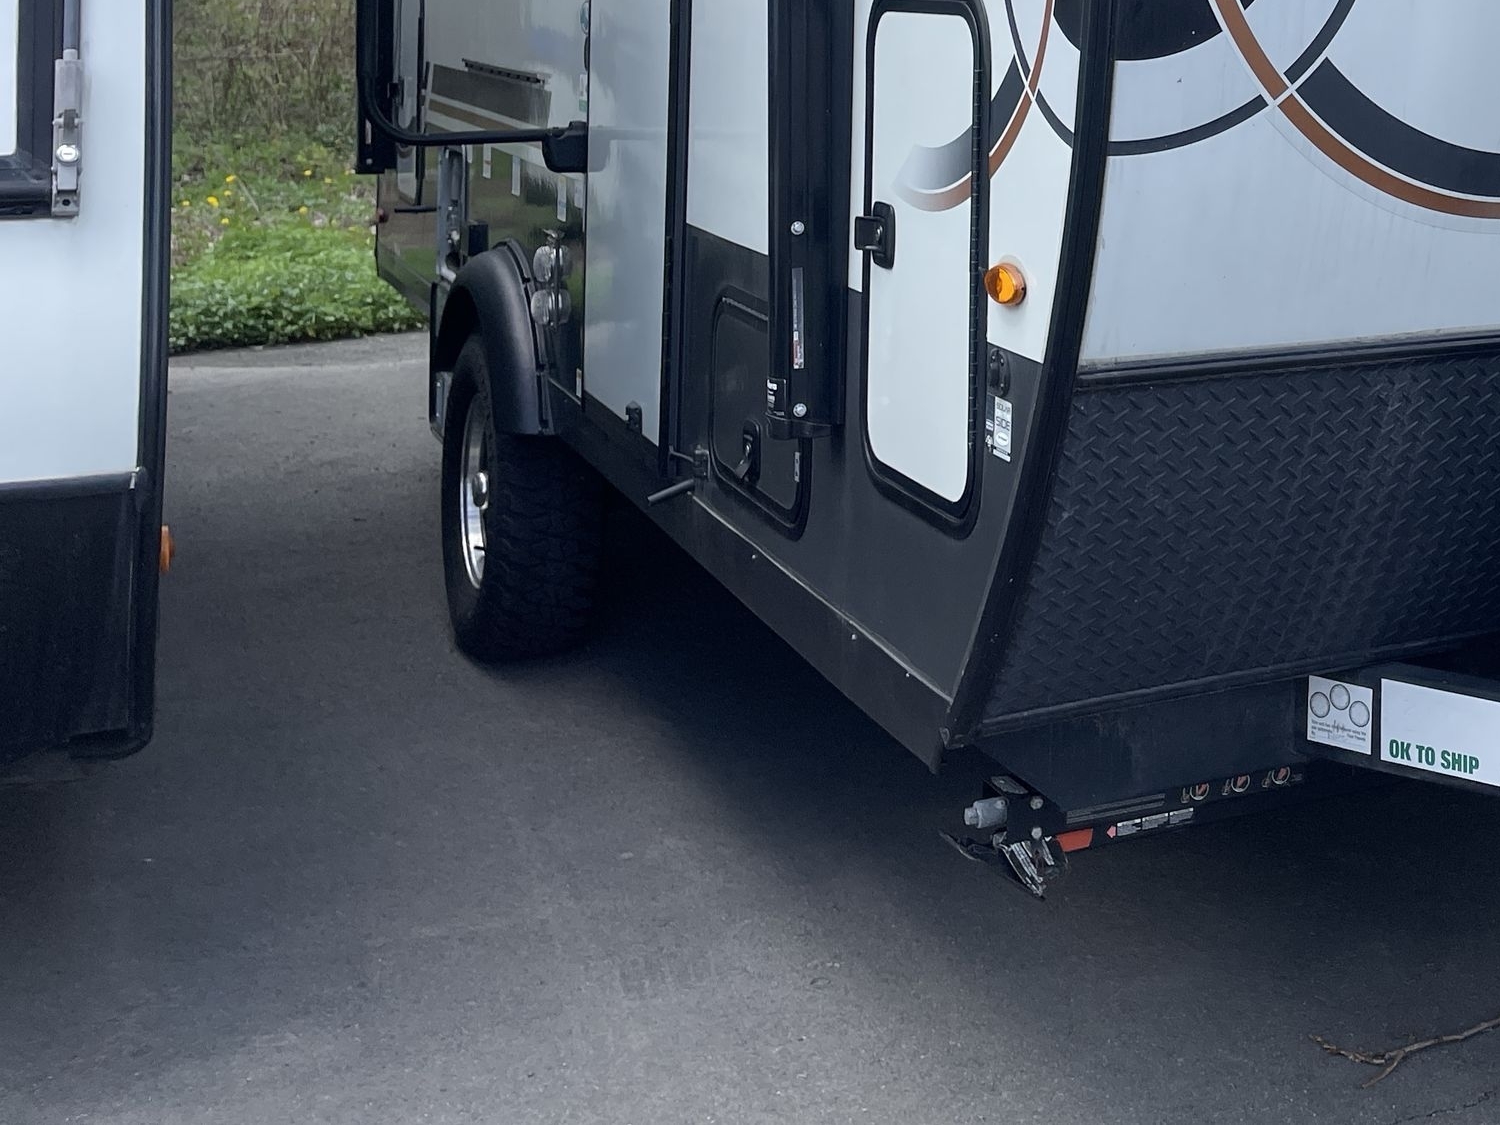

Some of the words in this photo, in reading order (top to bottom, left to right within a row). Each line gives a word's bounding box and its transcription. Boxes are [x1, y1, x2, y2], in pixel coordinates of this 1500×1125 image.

[1389, 739, 1411, 761] OK
[1416, 744, 1435, 766] TO
[1441, 750, 1479, 774] SHIP
